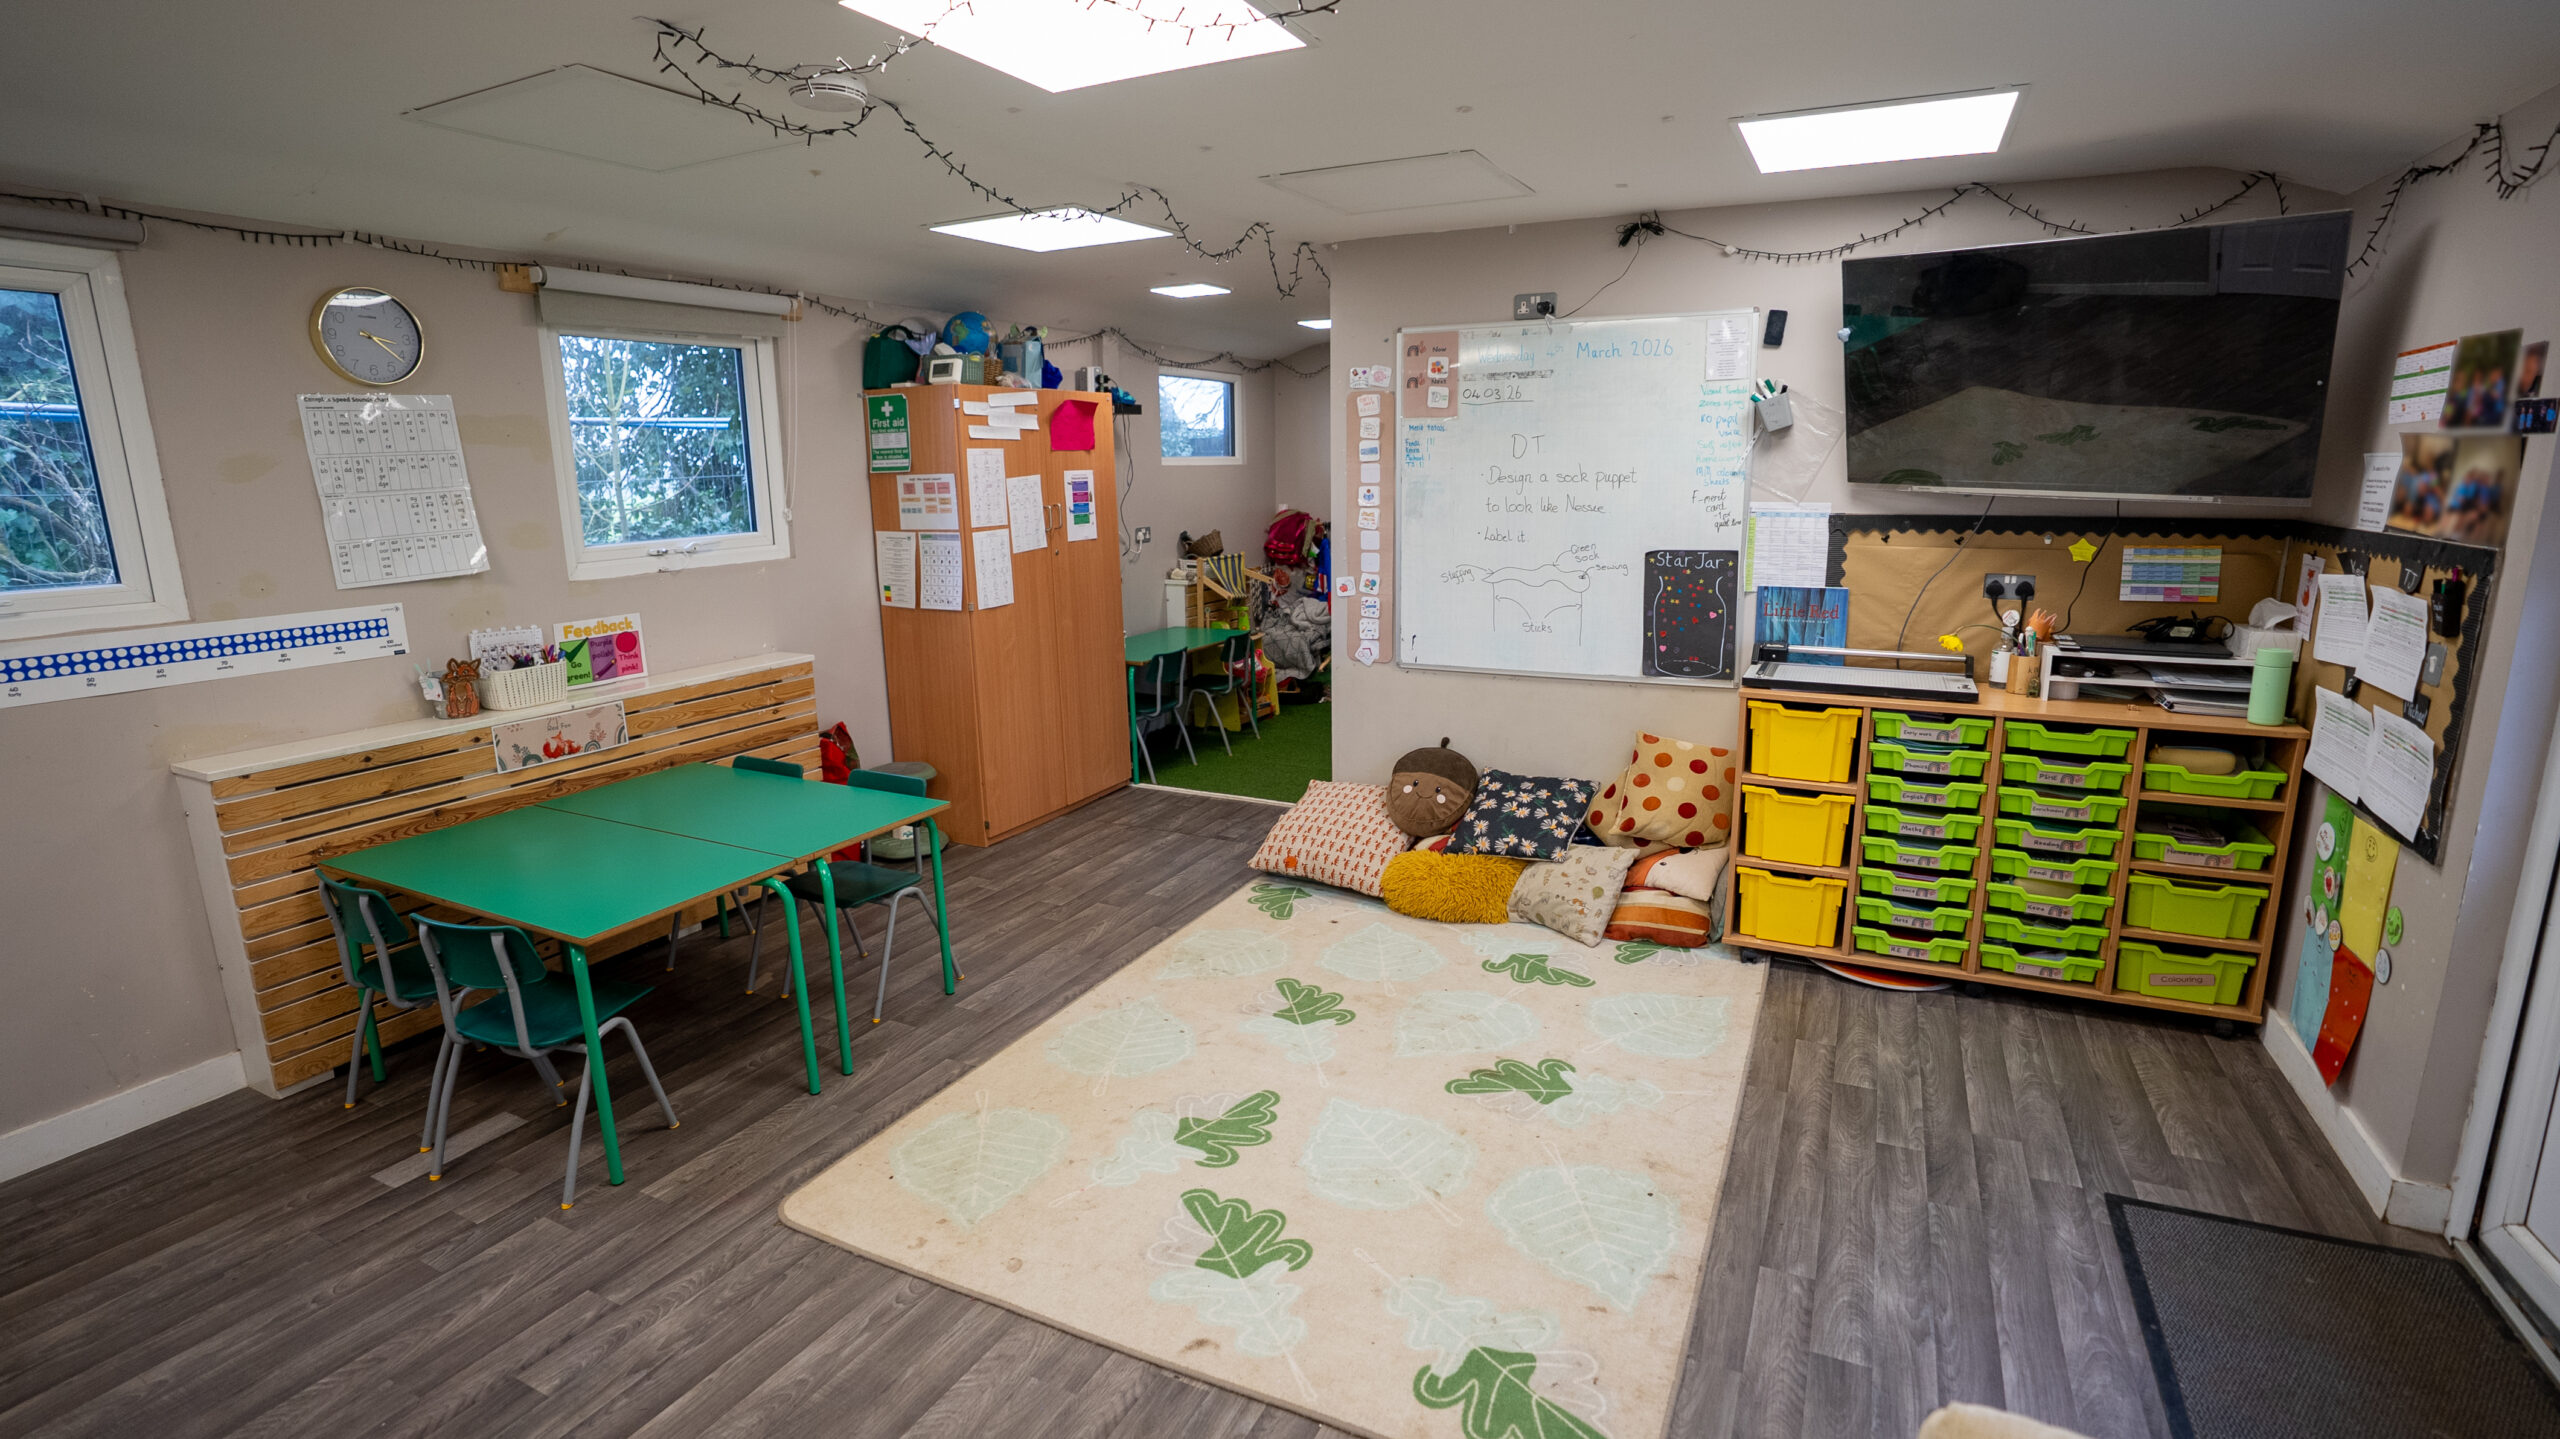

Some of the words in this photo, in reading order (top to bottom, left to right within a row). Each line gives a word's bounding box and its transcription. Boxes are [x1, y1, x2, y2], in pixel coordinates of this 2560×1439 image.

[331, 311, 345, 324] 10
[393, 317, 403, 328] 2
[327, 327, 337, 339] 9
[402, 334, 411, 346] 3
[336, 344, 346, 357] 8
[1576, 342, 1622, 359] March
[1631, 338, 1674, 358] 2026
[398, 350, 405, 361] 4
[350, 359, 359, 370] 7
[369, 364, 379, 376] 6
[387, 361, 396, 373] 5
[1463, 388, 1481, 400] 04
[1484, 388, 1502, 400] 03
[1506, 384, 1522, 400] 26
[872, 418, 890, 428] First
[892, 417, 905, 427] aid
[1716, 412, 1740, 429] pupil
[1486, 465, 1534, 496] Design
[1540, 473, 1549, 483] a
[1556, 463, 1589, 483] sock
[1595, 467, 1638, 492] puppet
[1485, 496, 1500, 513] to
[1505, 495, 1534, 513] look
[1540, 496, 1559, 513] like
[1705, 501, 1727, 513] card
[1484, 526, 1512, 542] Label
[1517, 530, 1526, 543] it
[1570, 543, 1597, 555] Green
[1574, 552, 1600, 563] sock
[1656, 551, 1694, 568] Star
[1695, 551, 1725, 569] Jar
[2405, 568, 2418, 590] TJ
[1764, 602, 1806, 618] Little
[1809, 604, 1840, 619] Red
[563, 616, 633, 639] Feedback
[619, 653, 639, 661] Think
[621, 663, 639, 673] pink!
[1903, 729, 1917, 737] Early
[1904, 762, 1928, 770] Phonics
[2039, 773, 2057, 781] PSHE
[1902, 793, 1924, 801] English
[2032, 806, 2065, 814] Enrichment
[1901, 824, 1922, 833] Maths
[2033, 840, 2060, 849] Reading
[1899, 855, 1915, 864] Topic
[1893, 916, 1909, 924] Arts
[2160, 976, 2203, 985] Colouring
